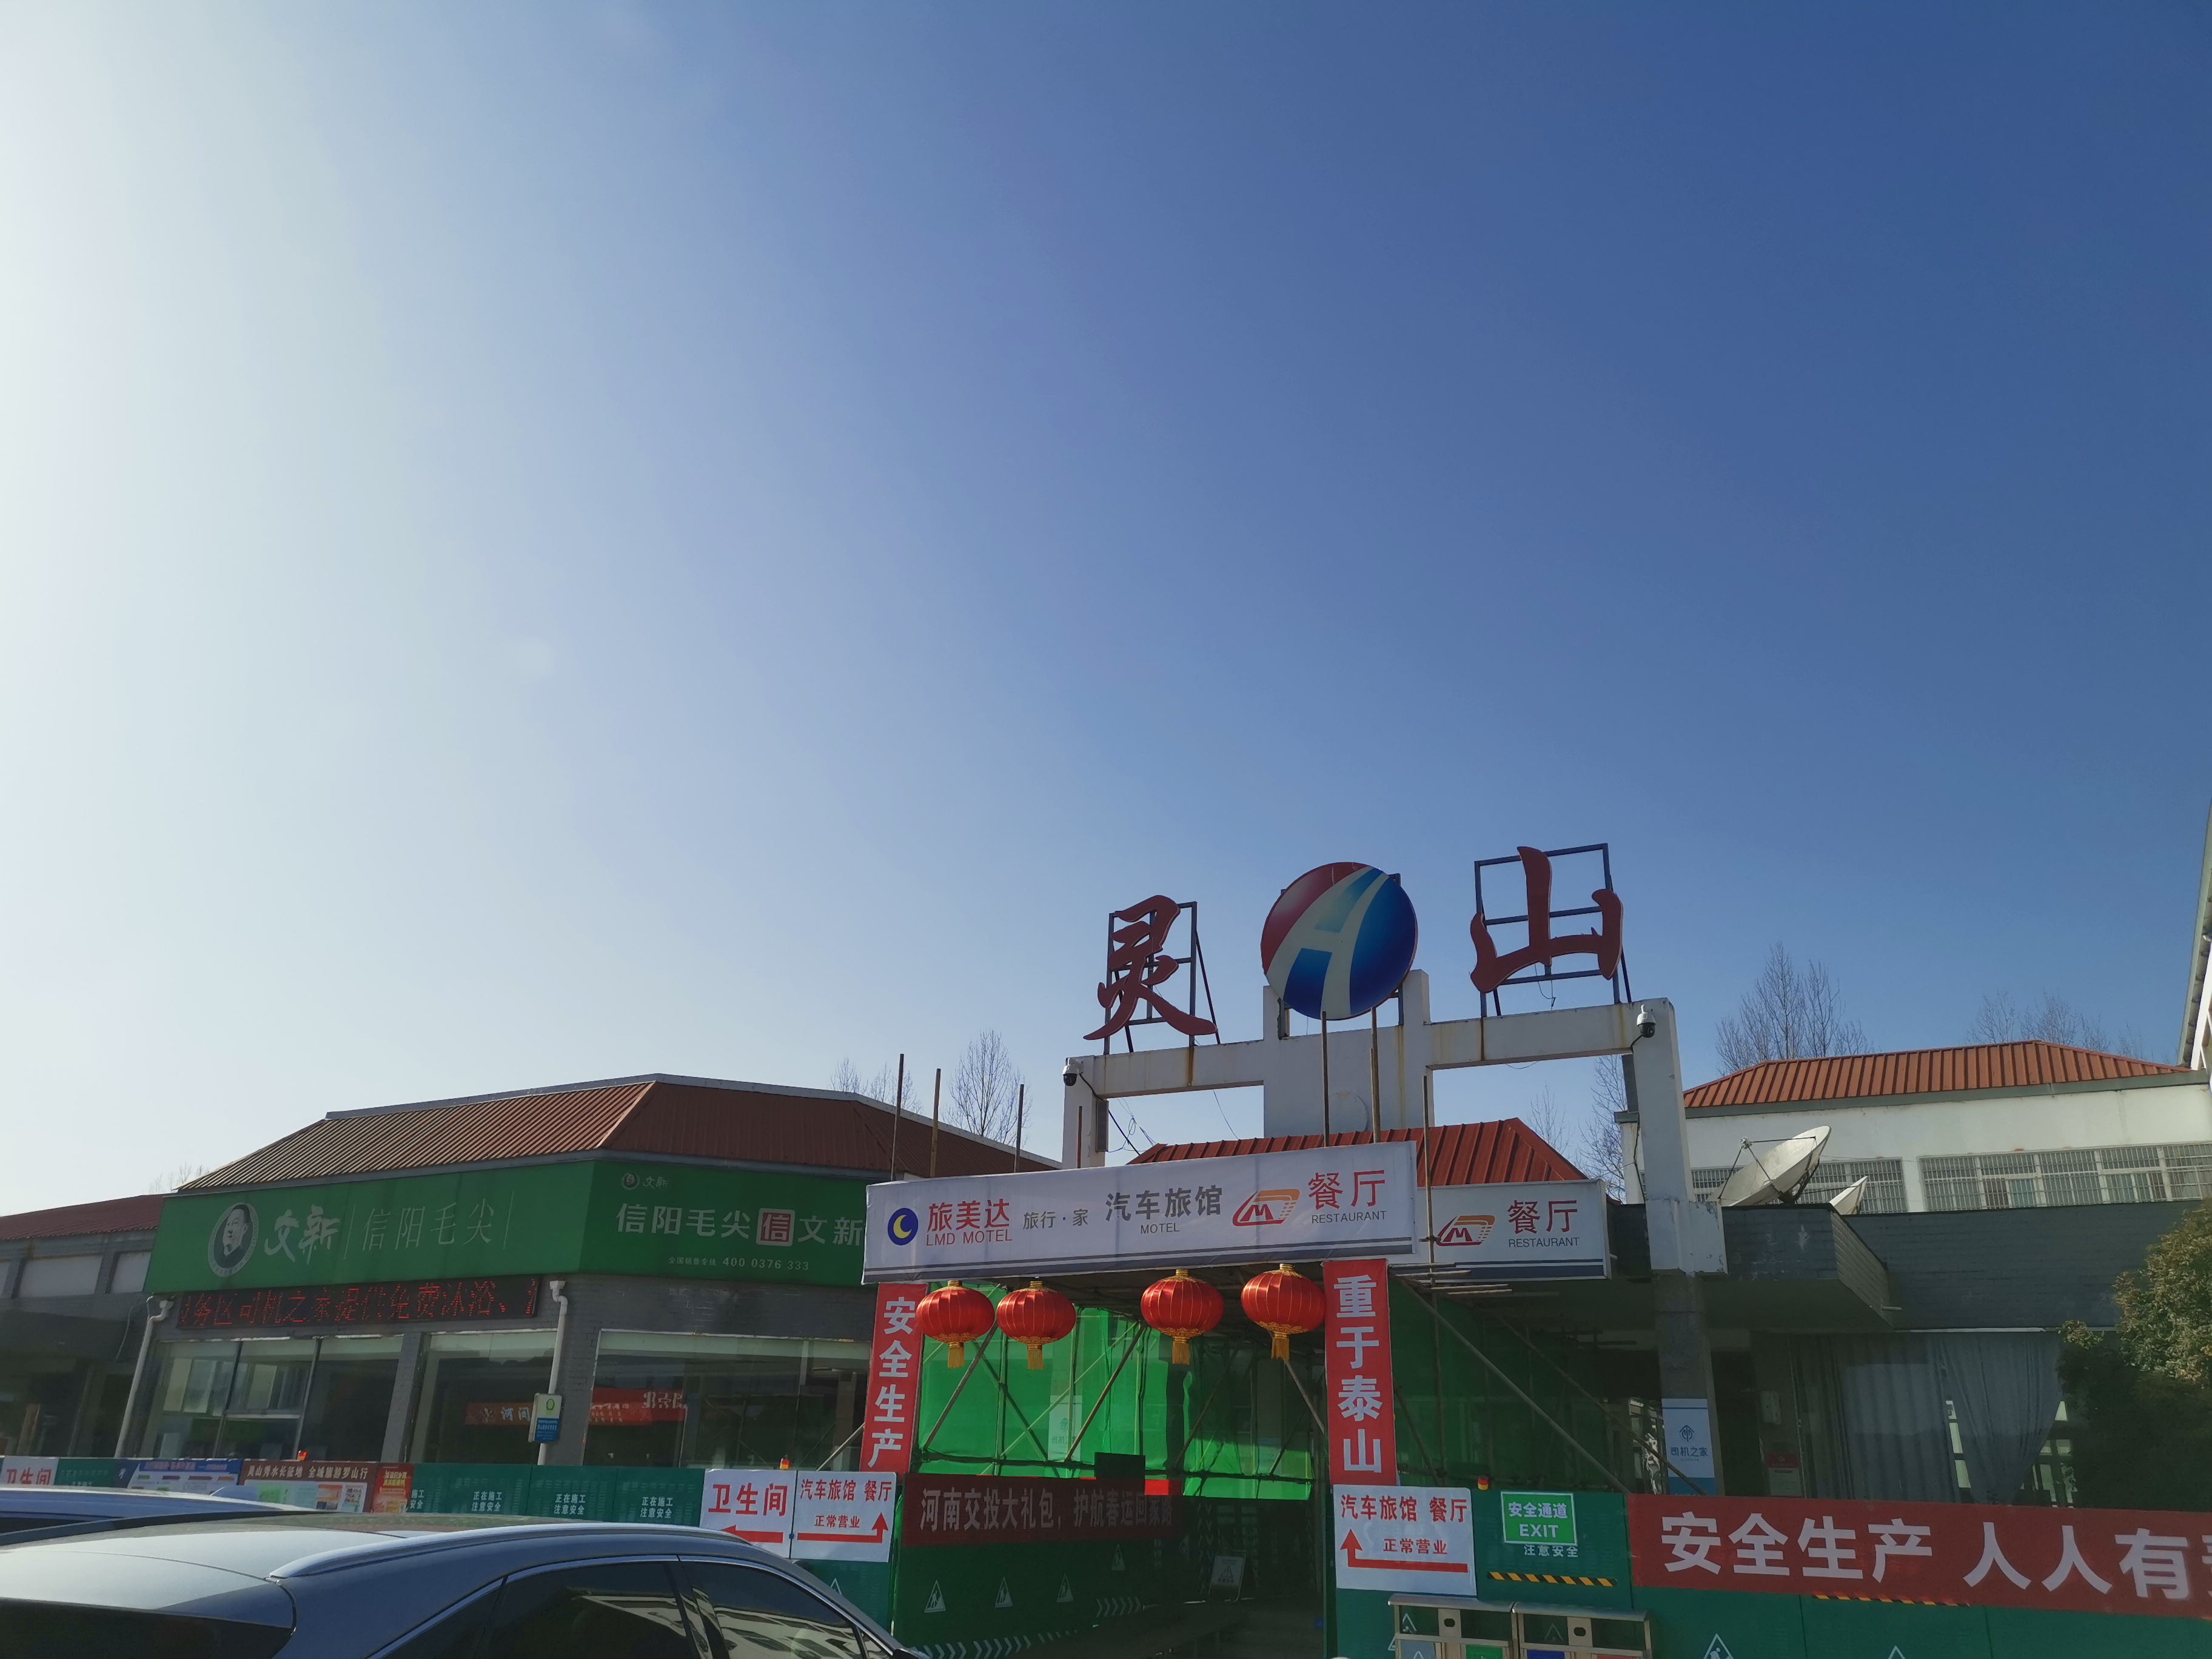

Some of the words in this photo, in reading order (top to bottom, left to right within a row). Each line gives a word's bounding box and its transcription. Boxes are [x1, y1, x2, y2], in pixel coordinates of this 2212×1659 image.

[1084, 894, 1218, 1041] 灵
[1470, 846, 1623, 994] 山
[926, 1199, 1010, 1234] 旅美达
[1104, 1184, 1223, 1222] 汽车旅馆
[1307, 1170, 1386, 1210] 餐厅
[362, 1199, 494, 1251] 信阳毛尖
[1507, 1199, 1578, 1235] 餐厅
[926, 1232, 957, 1247] LMD
[963, 1228, 1013, 1244] MOTEL
[1141, 1223, 1181, 1235] MOTEL
[1312, 1210, 1387, 1224] RESTAURANT
[1509, 1236, 1580, 1248] RESTAURANT
[722, 1257, 746, 1267] 400
[751, 1258, 782, 1270] 0376
[786, 1260, 810, 1271] 333
[867, 1296, 916, 1469] 安全生产
[1335, 1275, 1385, 1473] 重于泰山
[1671, 1446, 1708, 1457] 司机之家
[6, 1467, 52, 1486] 卫生间
[473, 1491, 502, 1501] 正在施工
[555, 1493, 586, 1504] 正在施工
[708, 1482, 788, 1517] 卫生间
[800, 1479, 856, 1502] 汽车旅馆
[863, 1480, 892, 1503] 餐厅
[471, 1501, 502, 1512] 注意安全
[554, 1504, 585, 1515] 注意安全
[641, 1496, 674, 1507] 正在施工
[1340, 1494, 1418, 1522] 汽车旅馆
[1429, 1497, 1468, 1523] 餐厅
[640, 1507, 673, 1519] 注意安全
[1508, 1502, 1569, 1520] 安全通道
[814, 1515, 860, 1529] 正常营业
[1519, 1523, 1559, 1539] EXIT
[1383, 1538, 1448, 1556] 正常营业
[1523, 1544, 1579, 1559] 注意安全
[1660, 1510, 1934, 1583] 安全生产
